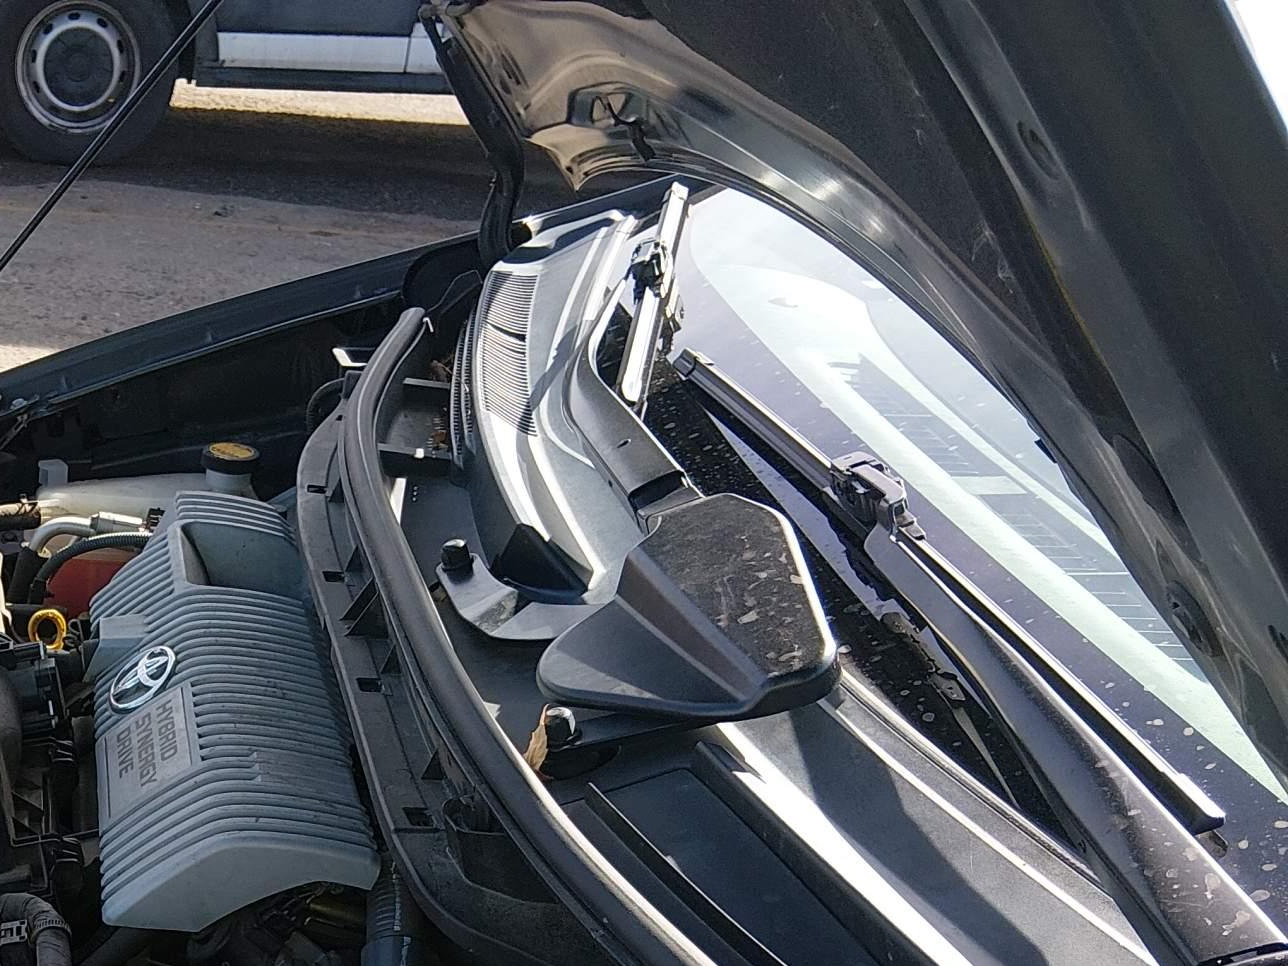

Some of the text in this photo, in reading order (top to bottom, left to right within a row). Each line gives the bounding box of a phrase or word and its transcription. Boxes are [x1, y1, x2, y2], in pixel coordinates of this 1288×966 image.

[117, 726, 134, 779] DRIVE
[135, 712, 157, 787] SYNERGY
[156, 699, 178, 761] HYBRID
